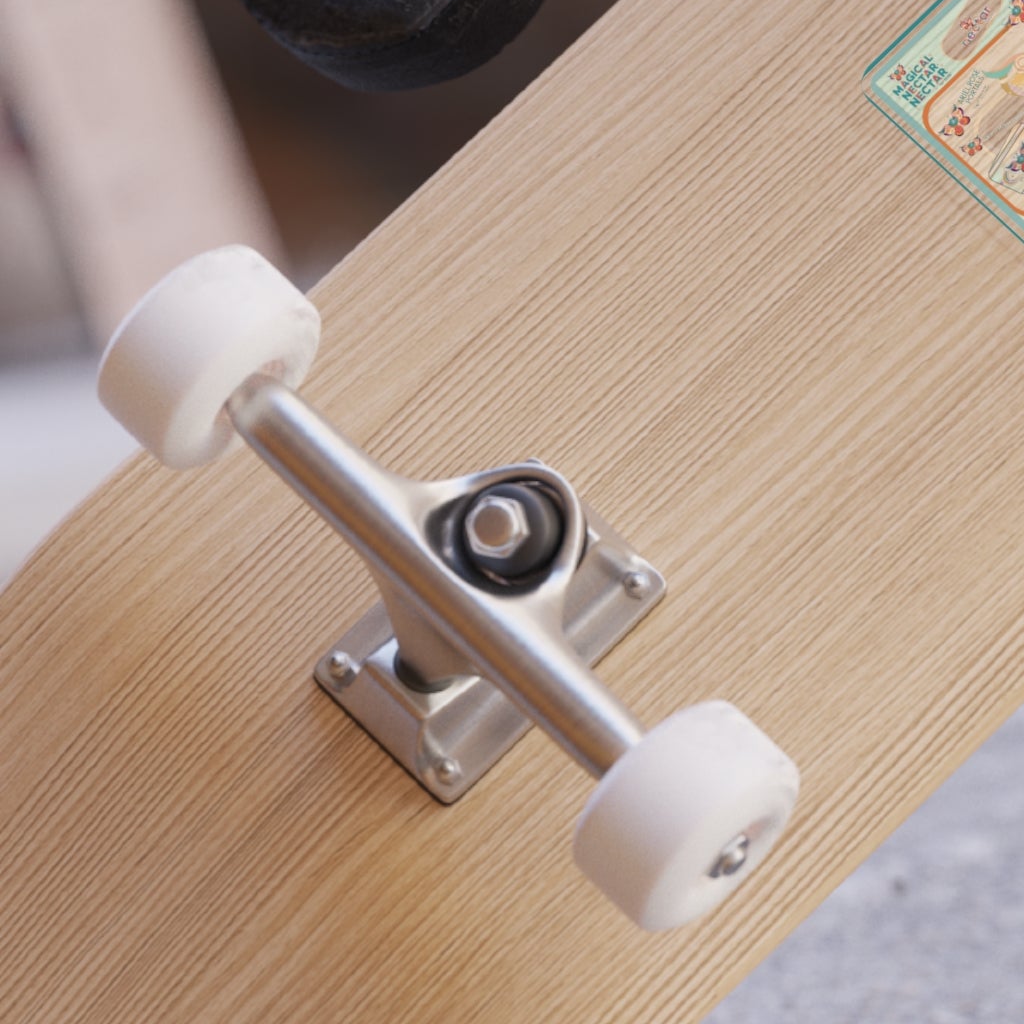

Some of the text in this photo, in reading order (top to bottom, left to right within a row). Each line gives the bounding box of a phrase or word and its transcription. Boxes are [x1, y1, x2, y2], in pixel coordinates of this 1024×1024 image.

[892, 55, 934, 96] MAGICAL
[901, 63, 939, 101] NECTAR
[909, 68, 948, 108] NECTAR
